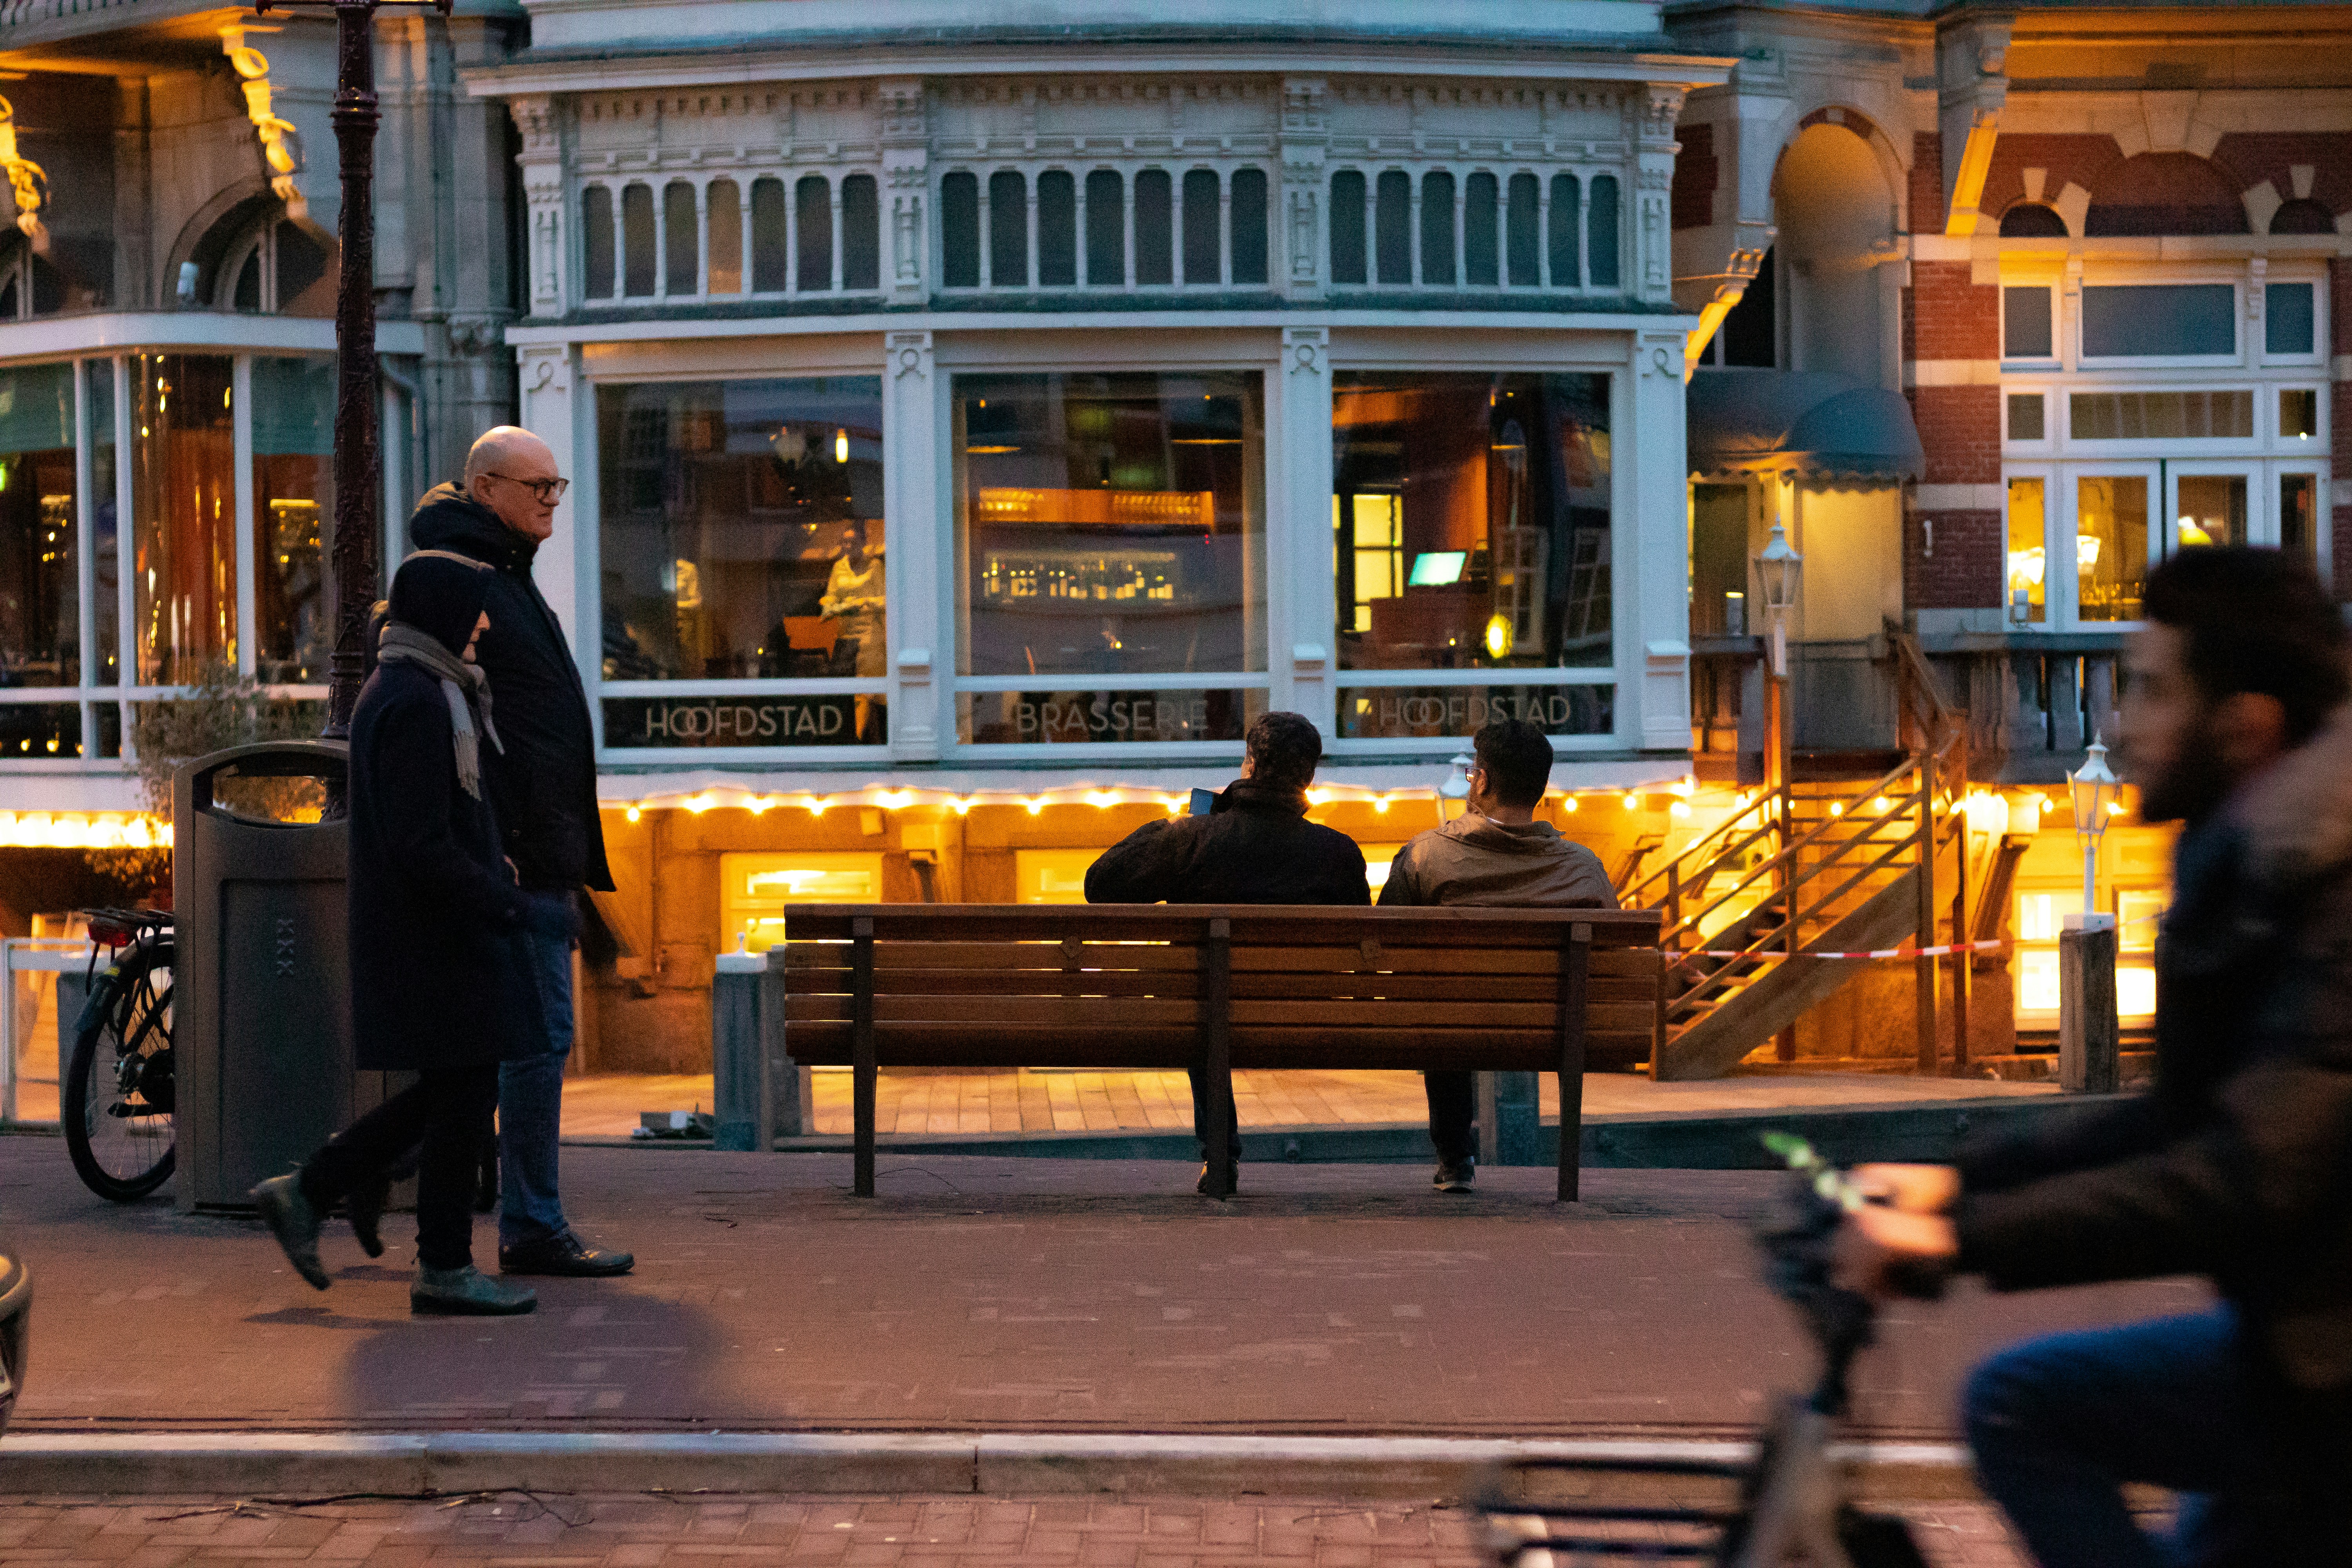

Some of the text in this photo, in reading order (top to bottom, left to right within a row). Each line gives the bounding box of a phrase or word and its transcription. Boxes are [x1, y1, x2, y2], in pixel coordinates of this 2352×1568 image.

[646, 706, 842, 738] HOOFDSTAD
[1016, 701, 1208, 732] BRASSERIE
[1380, 695, 1570, 726] HOOFDSTAD
